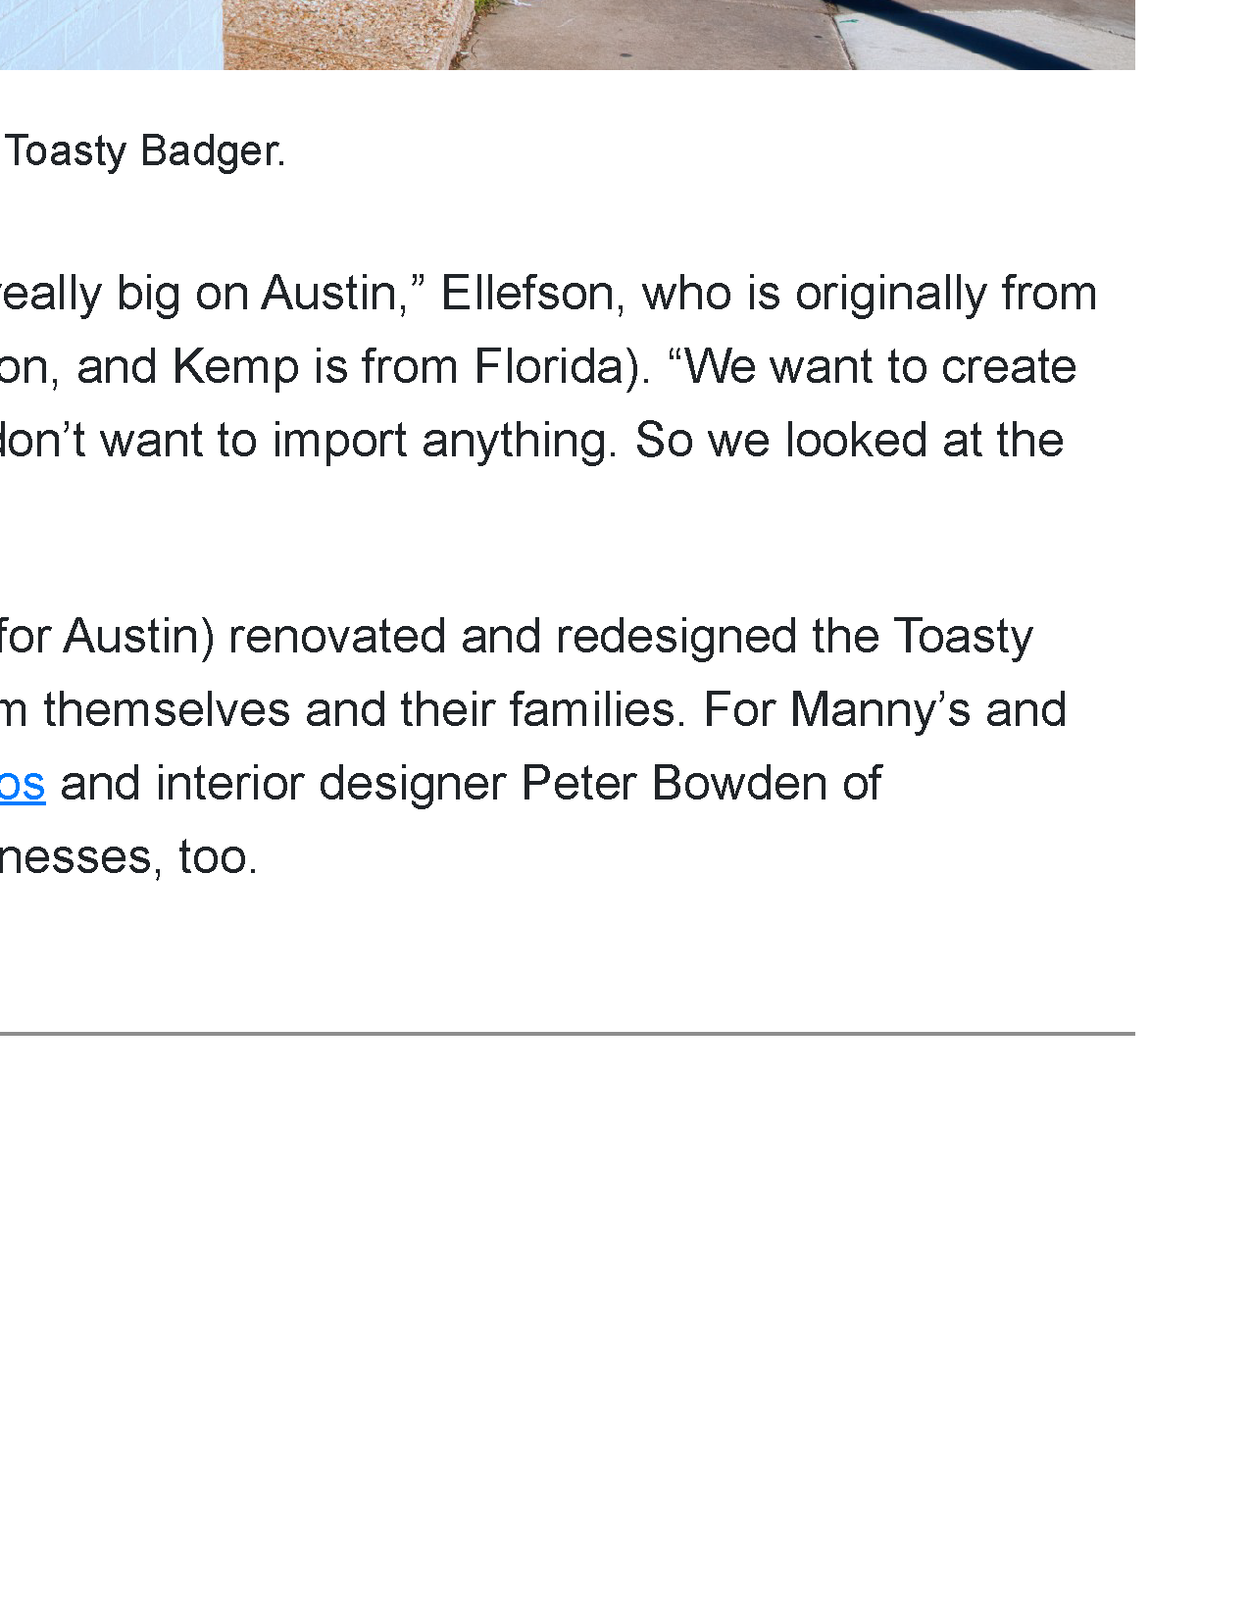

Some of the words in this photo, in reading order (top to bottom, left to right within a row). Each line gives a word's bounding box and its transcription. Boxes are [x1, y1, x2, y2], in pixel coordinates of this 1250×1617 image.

[5, 134, 127, 174] Toasty
[143, 134, 283, 174] Badger.
[119, 274, 179, 319] big
[197, 283, 247, 309] on
[261, 274, 424, 317] Austin,”
[444, 274, 623, 317] Ellefson,
[642, 274, 731, 309] who
[750, 274, 780, 309] is
[797, 274, 987, 319] originally
[1002, 274, 1095, 309] from
[78, 347, 155, 383] and
[175, 347, 298, 393] Kemp
[317, 347, 347, 383] is
[362, 347, 456, 383] from
[477, 347, 648, 393] Florida).
[669, 347, 755, 383] “We
[769, 348, 873, 383] want
[888, 348, 927, 383] to
[943, 348, 1076, 383] create
[100, 422, 203, 456] want
[218, 422, 256, 456] to
[275, 421, 407, 466] import
[423, 421, 615, 466] anything.
[637, 420, 692, 457] So
[708, 430, 769, 456] we
[788, 421, 926, 457] looked
[944, 422, 982, 456] at
[997, 421, 1063, 456] the
[63, 617, 213, 662] Austin)
[231, 617, 444, 653] renovated
[463, 617, 539, 653] and
[559, 617, 795, 662] redesigned
[813, 617, 879, 653] the
[894, 617, 1033, 662] Toasty
[44, 691, 289, 726] themselves
[307, 691, 384, 726] and
[401, 691, 496, 726] their
[510, 691, 683, 726] families.
[707, 691, 777, 726] For
[793, 691, 970, 736] Manny’s
[987, 691, 1065, 726] and
[62, 764, 138, 800] and
[159, 764, 305, 800] interior
[320, 764, 507, 809] designer
[524, 764, 637, 800] Peter
[655, 764, 826, 800] Bowden
[844, 764, 883, 800] of
[179, 839, 255, 873] too.
